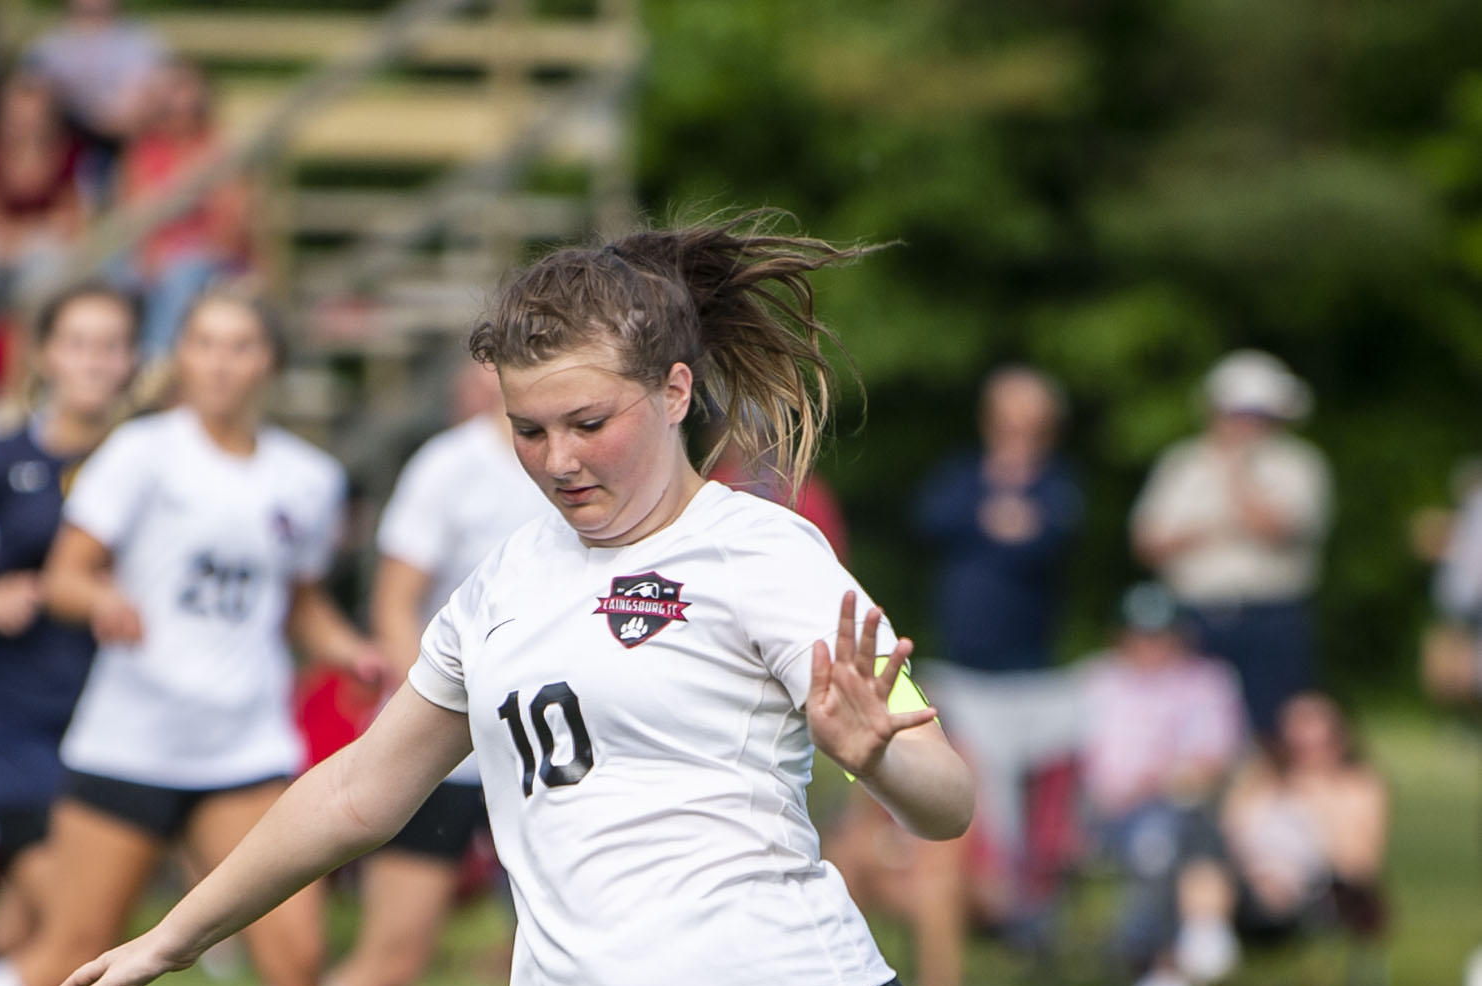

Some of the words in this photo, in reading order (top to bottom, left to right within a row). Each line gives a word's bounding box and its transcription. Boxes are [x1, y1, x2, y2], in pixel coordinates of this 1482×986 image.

[603, 599, 665, 614] LAINGSBURG
[667, 604, 678, 616] FC
[497, 681, 594, 798] 10
